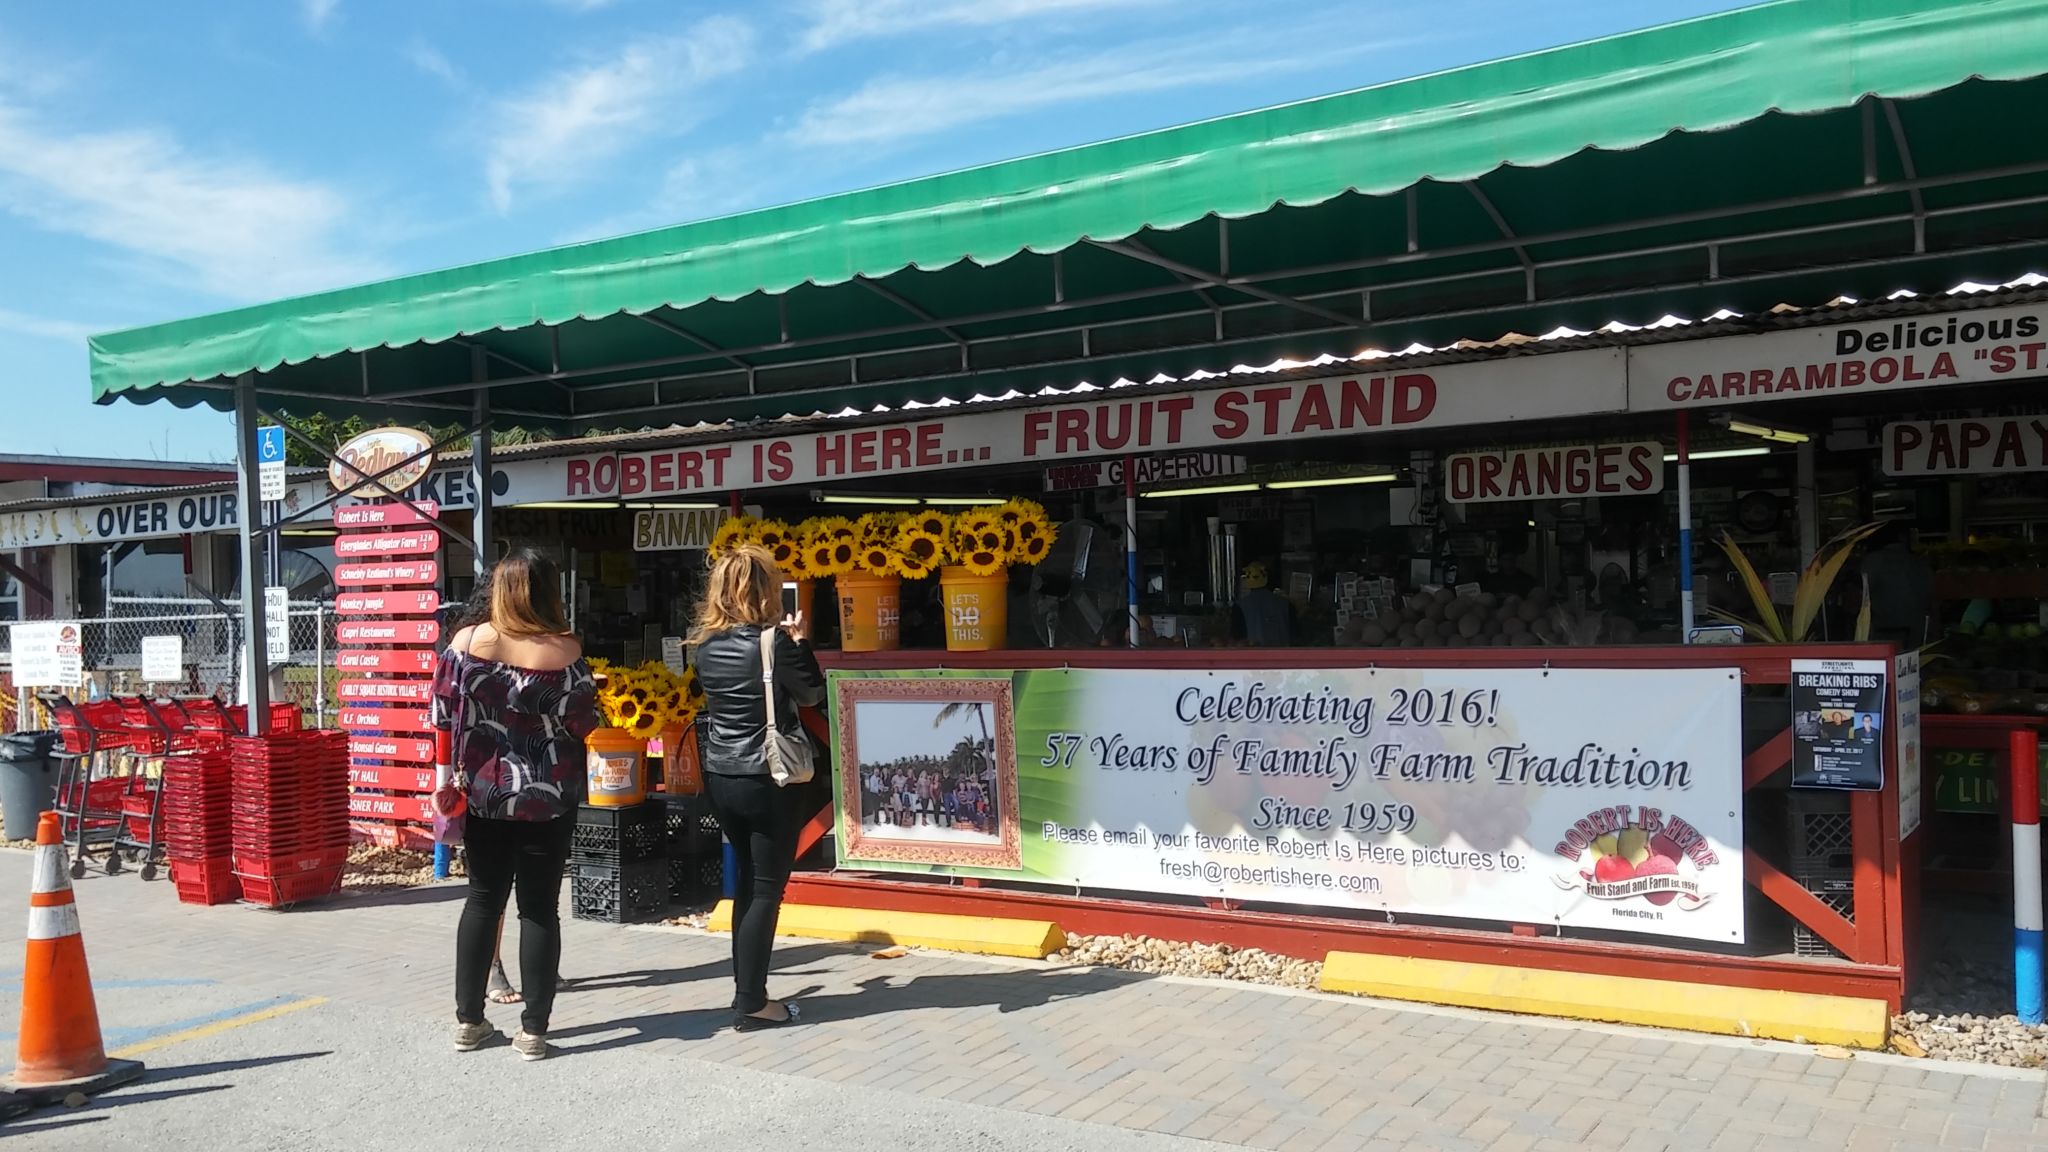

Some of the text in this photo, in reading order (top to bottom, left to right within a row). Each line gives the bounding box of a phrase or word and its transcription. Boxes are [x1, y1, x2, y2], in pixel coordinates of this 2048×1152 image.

[1837, 316, 2039, 355] Delicious
[1666, 342, 2048, 402] CARRAMBOLA "ST
[567, 373, 1438, 496] ROBERT IS HERE... FRUIT STAND
[340, 442, 422, 488] Redland
[1107, 452, 1240, 485] GAPEFRUIT
[1451, 445, 1653, 500] ORANGES
[351, 470, 475, 506] AKES
[96, 493, 237, 538] OVER OUR
[338, 510, 385, 524] Robert Is Here
[340, 537, 418, 553] Everglades Alligator Farm
[394, 566, 415, 578] Winery
[265, 594, 283, 606] THOU
[340, 598, 385, 611] Monkey Jungle
[951, 594, 980, 605] LET'S
[266, 611, 285, 622] HALL
[951, 606, 980, 627] DO
[266, 626, 280, 638] NOT
[360, 627, 396, 638] Restaurant
[952, 628, 984, 641] THIS.
[268, 642, 285, 654] IELD
[341, 654, 380, 666] Coral Castle
[1798, 674, 1878, 689] BREAKING RIBS
[398, 684, 418, 697] VILLAGE
[1816, 688, 1860, 697] COMEDY SHOW
[1175, 682, 1499, 737] Celebrating 2016!
[356, 713, 380, 725] Orchids
[353, 742, 375, 753] Bonsai
[375, 742, 397, 754] Garden
[1041, 733, 1692, 789] 57 Years of Family Farm Tradition
[348, 770, 379, 783] TY HALL
[667, 775, 695, 786] THIS.
[373, 800, 395, 814] PARK
[1253, 798, 1416, 834] Since 1959
[1554, 804, 1720, 872] ROBERT IS HERE
[1043, 823, 1527, 871] Please email your favorite Robert Is Here pictures to:
[1160, 858, 1382, 893] fresh@robertishere.com
[1586, 882, 1607, 897] Fruit
[1607, 880, 1632, 896] Stand
[1632, 877, 1648, 892] and
[1649, 876, 1670, 890] Farm
[1612, 908, 1638, 918] Florida
[1656, 911, 1664, 920] FL
